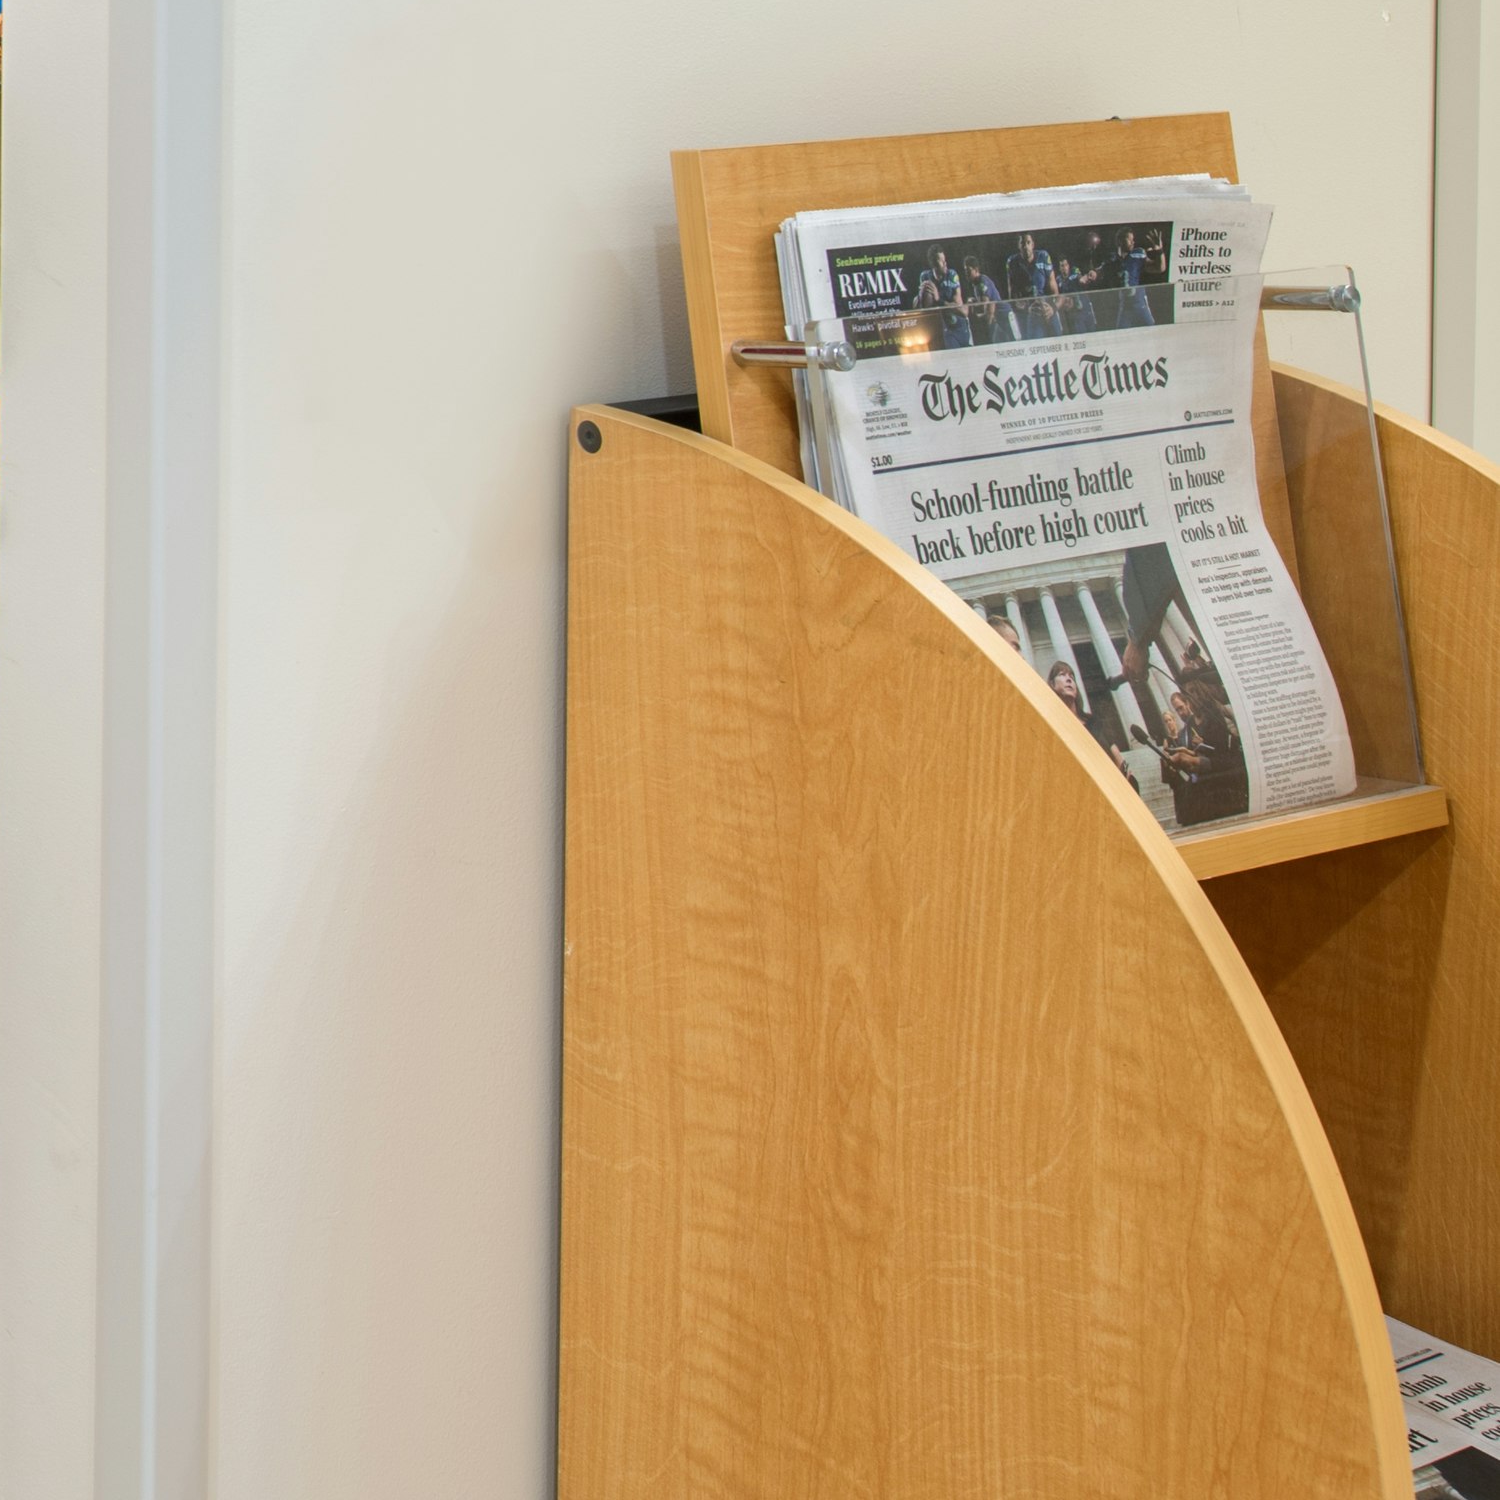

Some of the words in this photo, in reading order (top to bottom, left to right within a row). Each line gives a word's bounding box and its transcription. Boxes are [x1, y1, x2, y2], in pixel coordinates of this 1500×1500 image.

[1180, 228, 1227, 241] iPhone
[836, 255, 873, 268] Seahawks
[874, 253, 905, 266] preview
[1179, 244, 1215, 258] shifts
[1218, 247, 1232, 258] to
[1178, 261, 1231, 275] wireless
[838, 268, 908, 298] REMIX
[848, 299, 877, 310] Evolving
[877, 297, 901, 307] Russell
[878, 319, 901, 331] pivotal
[902, 318, 918, 329] year
[996, 348, 1026, 359] THURSDAY,
[1029, 343, 1062, 355] SEPTEMBER
[1073, 341, 1086, 351] 2016
[918, 369, 982, 425] The
[983, 358, 1080, 414] Seattle
[1079, 350, 1169, 400] Times
[1000, 419, 1029, 430] WINNER
[1030, 417, 1038, 426] OF
[1048, 412, 1079, 423] PULITZER
[1080, 409, 1103, 419] PRIZES
[871, 454, 893, 468] $1.00
[1164, 441, 1206, 466] Climb
[911, 473, 1072, 523] School-funding
[1074, 461, 1134, 497] battle
[1168, 472, 1184, 492] in
[1186, 467, 1226, 490] house
[1173, 497, 1214, 523] prices
[912, 528, 965, 565] back
[967, 520, 1037, 555] before
[1039, 508, 1090, 548] high
[1094, 502, 1149, 535] court
[1180, 520, 1215, 544] cools
[1217, 522, 1227, 537] a
[1230, 514, 1249, 534] bit
[1399, 1373, 1448, 1398] Climb
[1418, 1400, 1449, 1413] in
[1435, 1381, 1492, 1406] house
[1452, 1402, 1500, 1430] prices
